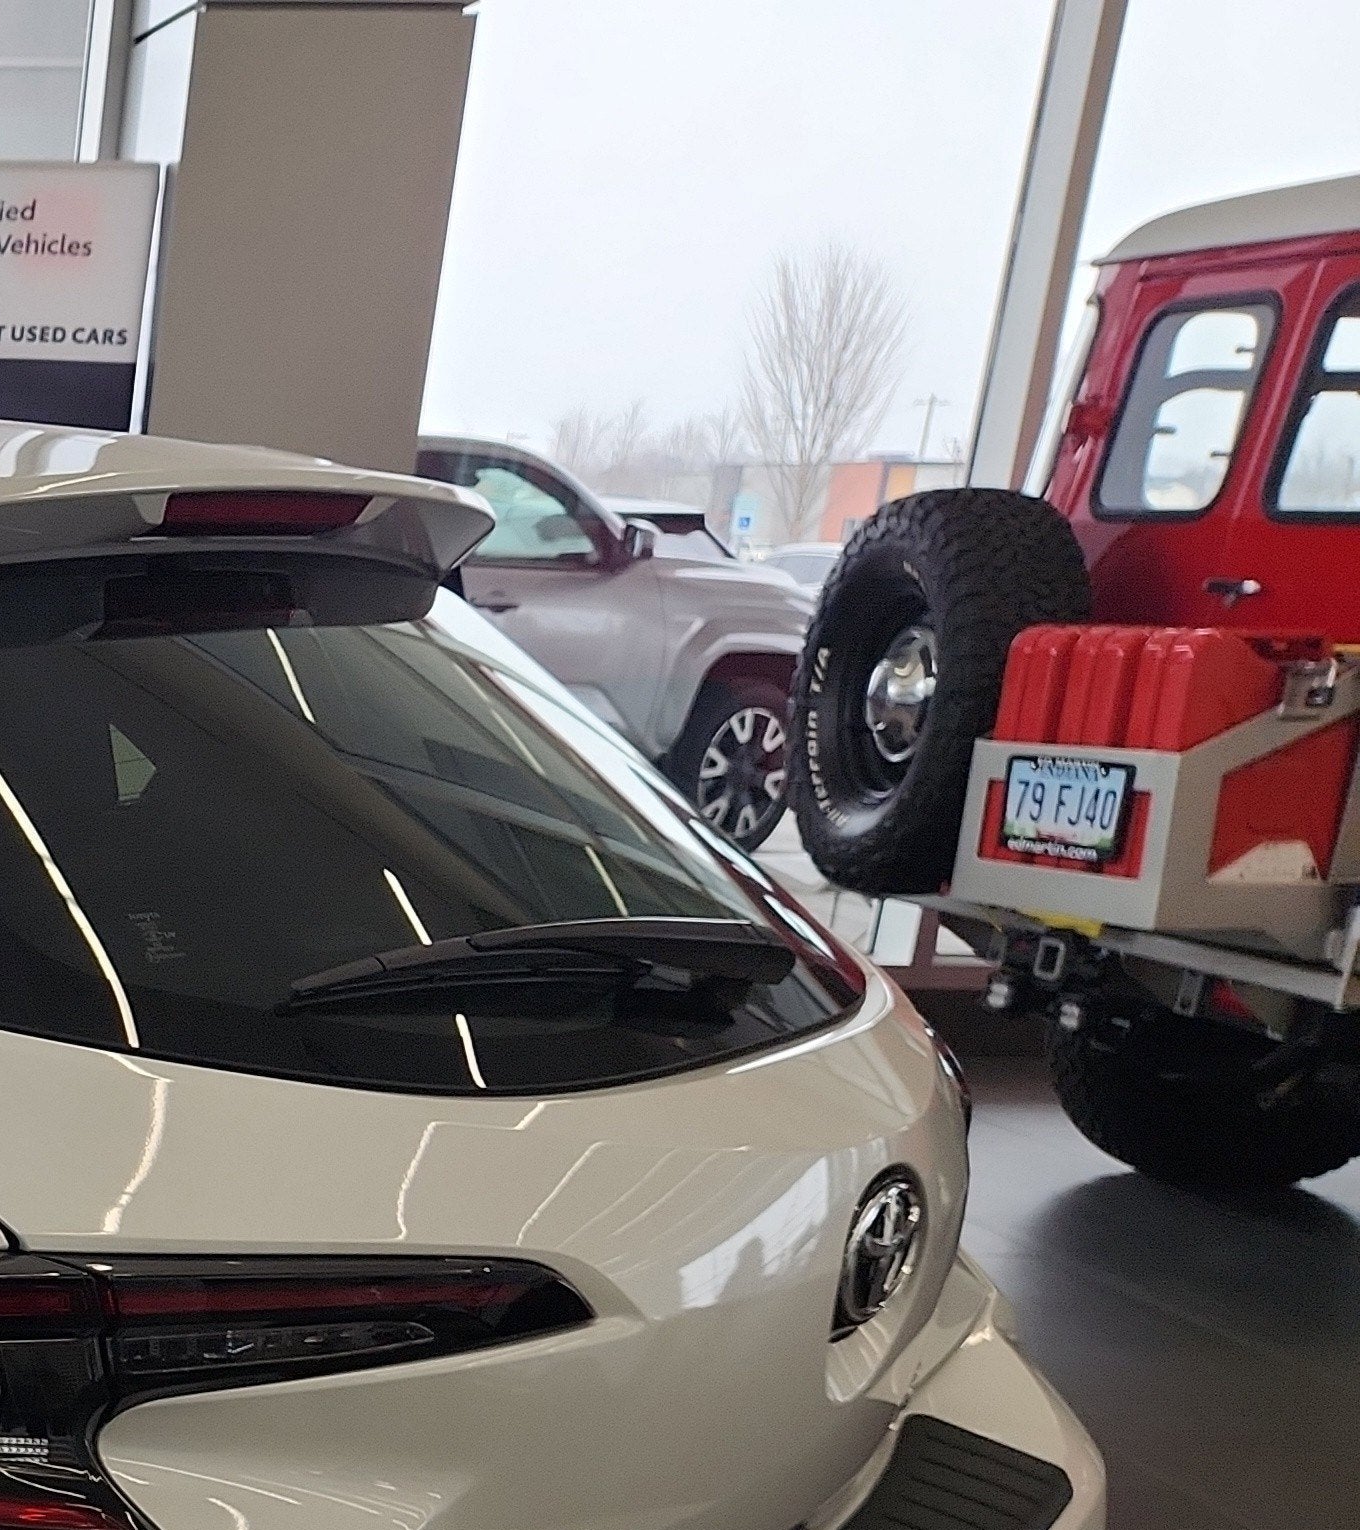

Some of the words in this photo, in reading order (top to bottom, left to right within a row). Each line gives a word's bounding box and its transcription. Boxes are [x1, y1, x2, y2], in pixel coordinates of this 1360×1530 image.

[11, 326, 66, 343] USED
[72, 328, 128, 346] CARS
[1016, 780, 1046, 822] 79
[1054, 784, 1117, 831] FJ40
